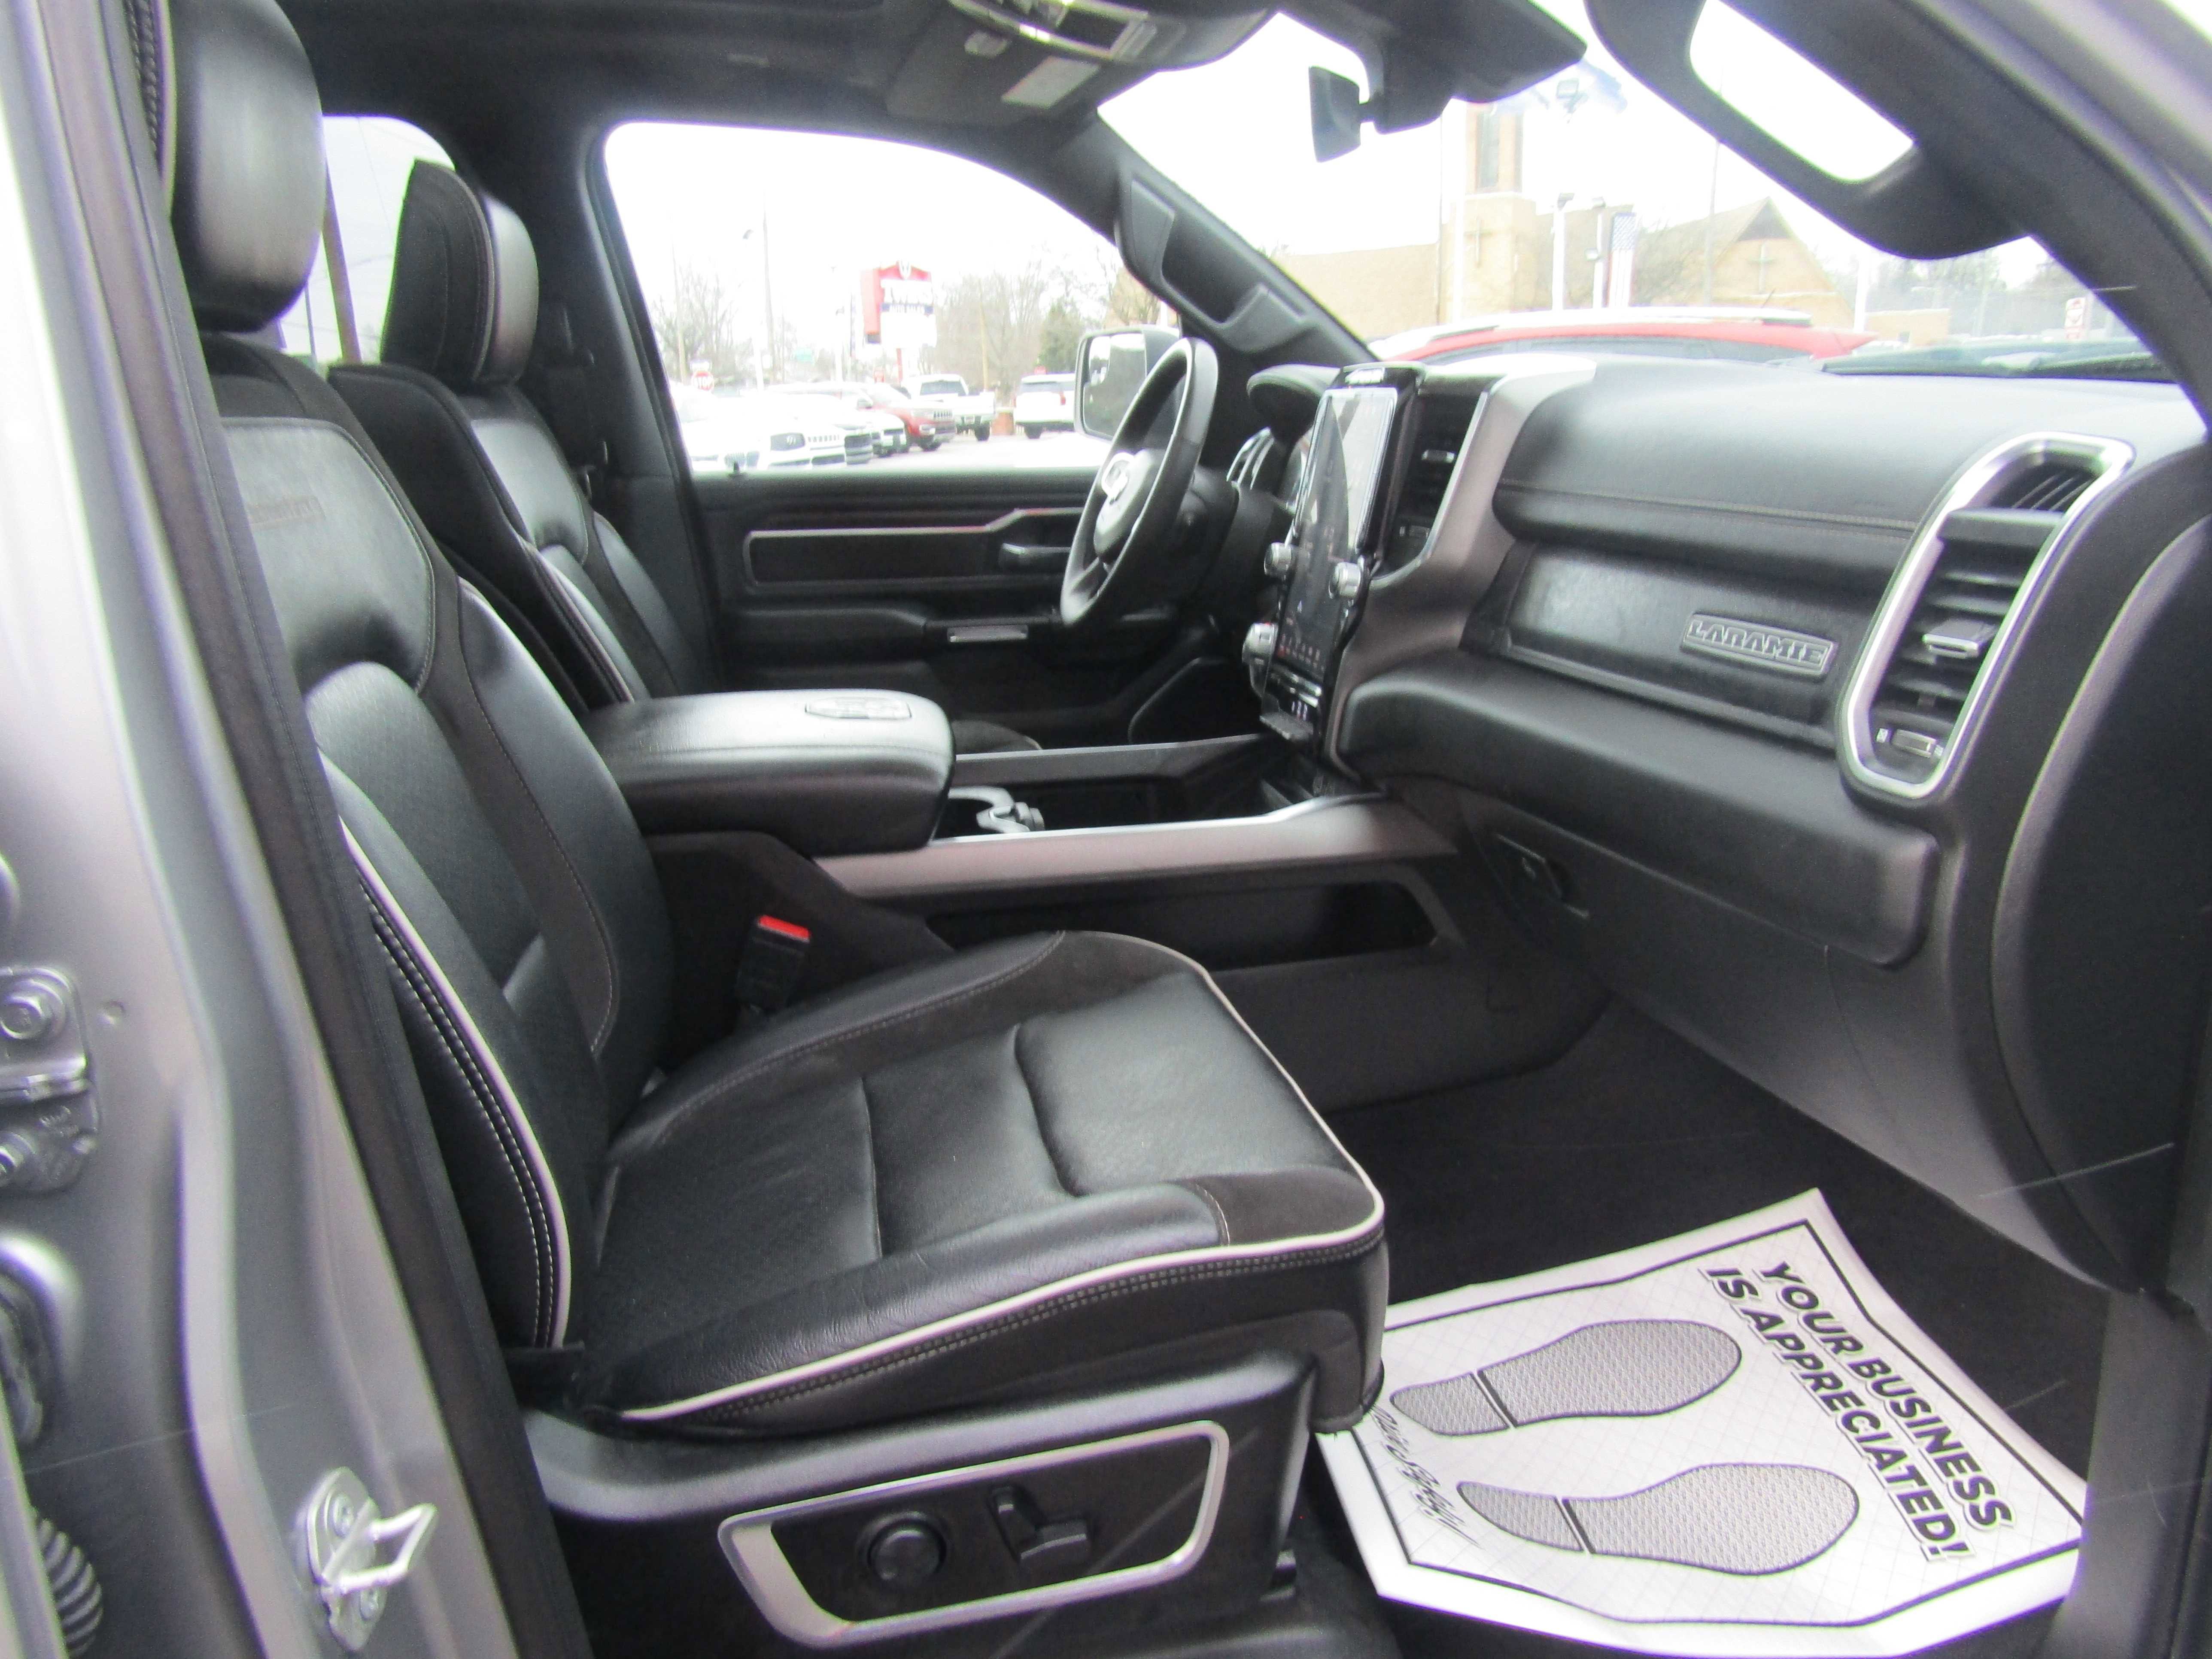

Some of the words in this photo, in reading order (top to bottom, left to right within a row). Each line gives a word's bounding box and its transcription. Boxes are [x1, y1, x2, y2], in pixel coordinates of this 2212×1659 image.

[1686, 620, 1828, 666] LARAMIE
[1704, 1267, 1759, 1300] IS
[1738, 1308, 1970, 1556] APPRECIATED!
[1758, 1261, 1864, 1355] YOUR
[1847, 1357, 2012, 1527] BUSINESS
